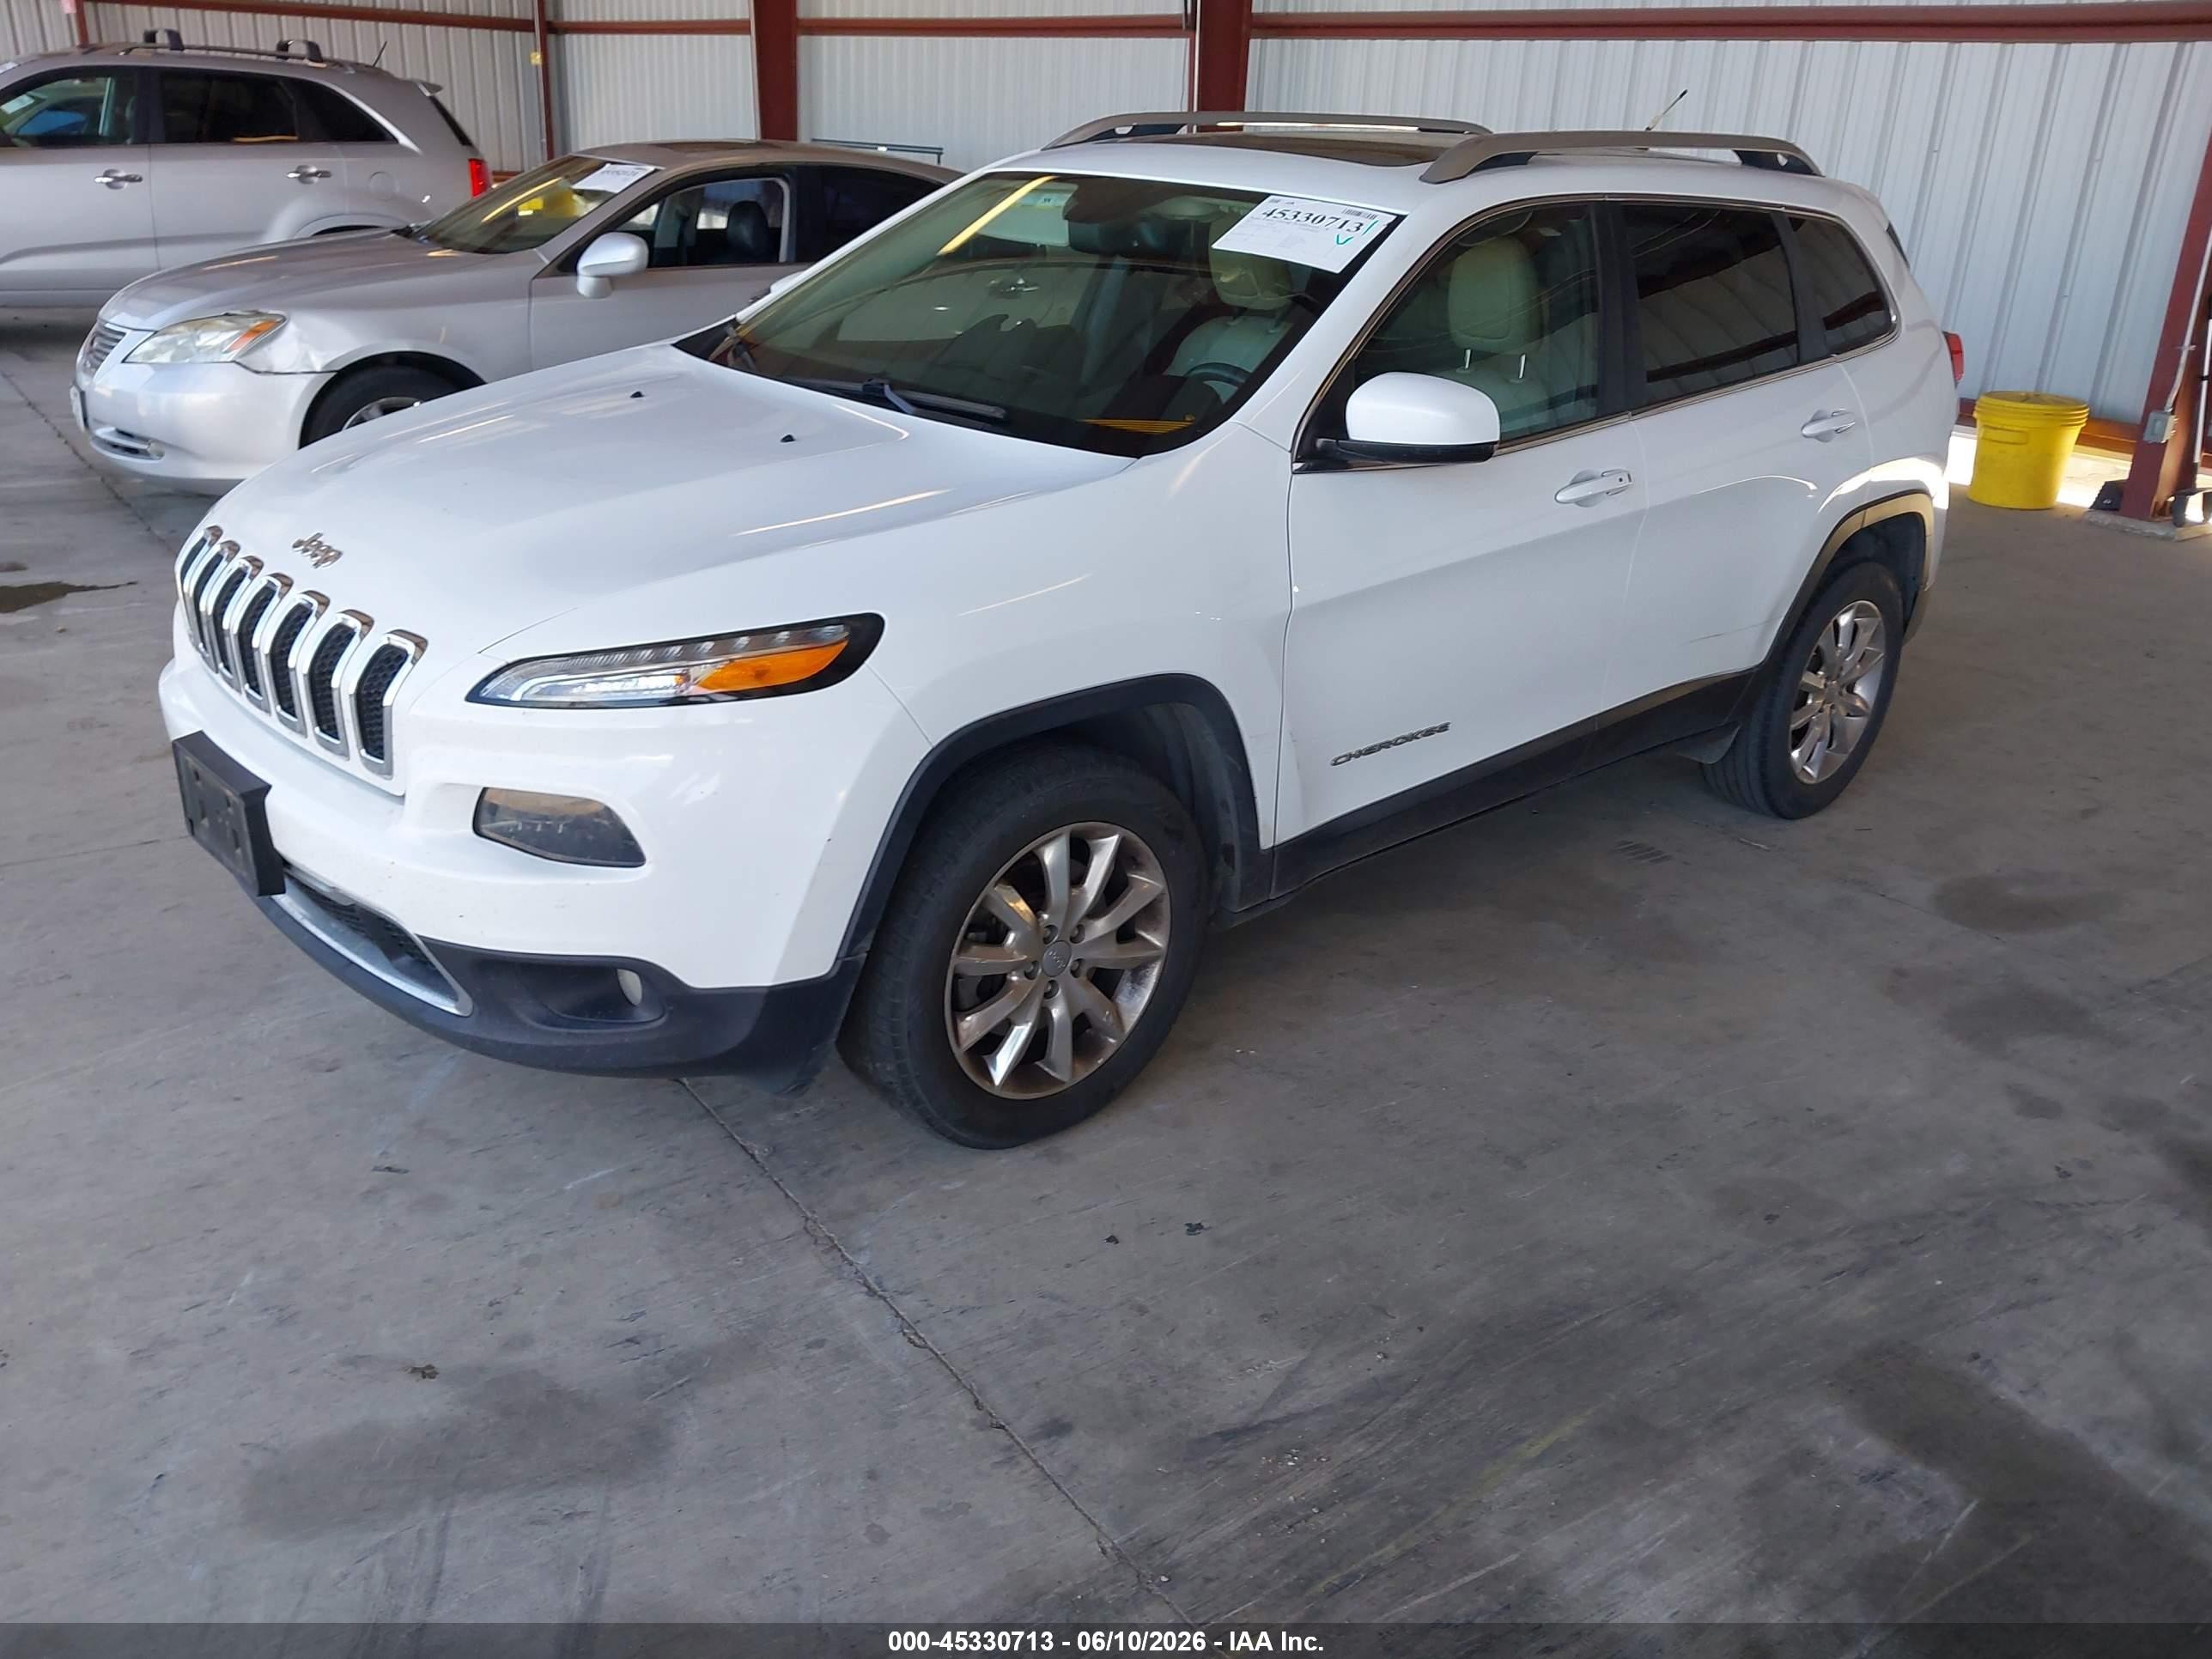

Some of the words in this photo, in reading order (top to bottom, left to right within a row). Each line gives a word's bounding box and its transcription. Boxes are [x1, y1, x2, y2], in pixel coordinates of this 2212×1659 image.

[1262, 207, 1364, 233] 45330713
[292, 532, 343, 568] Jeep
[1331, 722, 1450, 766] CHEROKEE
